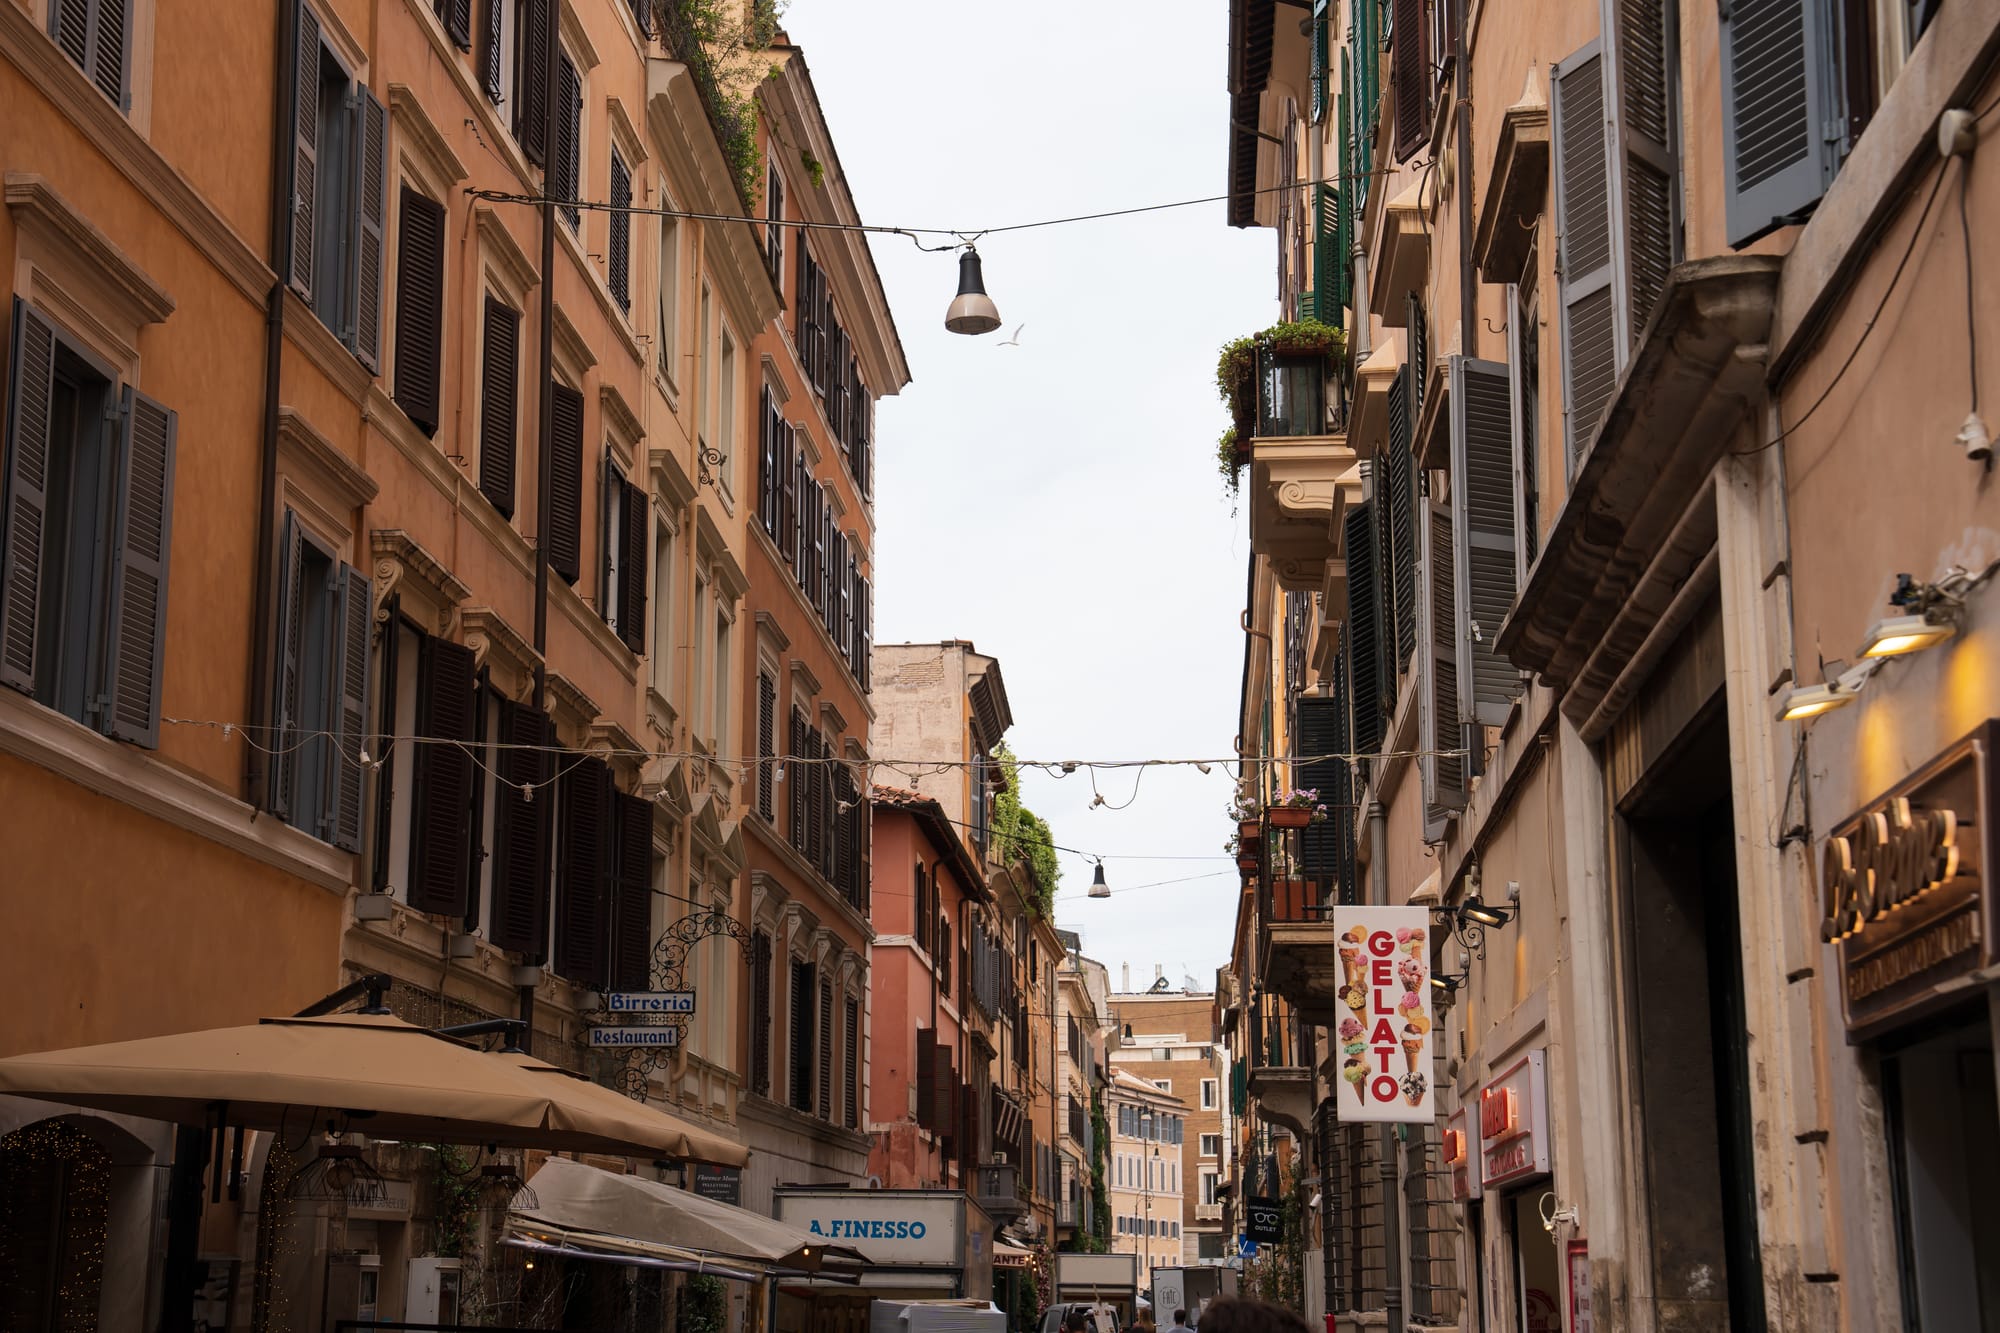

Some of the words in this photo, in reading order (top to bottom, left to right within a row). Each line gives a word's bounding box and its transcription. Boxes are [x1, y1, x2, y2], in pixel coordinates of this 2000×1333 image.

[611, 994, 691, 1010] Birreria
[1368, 930, 1399, 1103] GELATO
[594, 1030, 672, 1044] Restaurant
[810, 1219, 926, 1239] A.FINESSO
